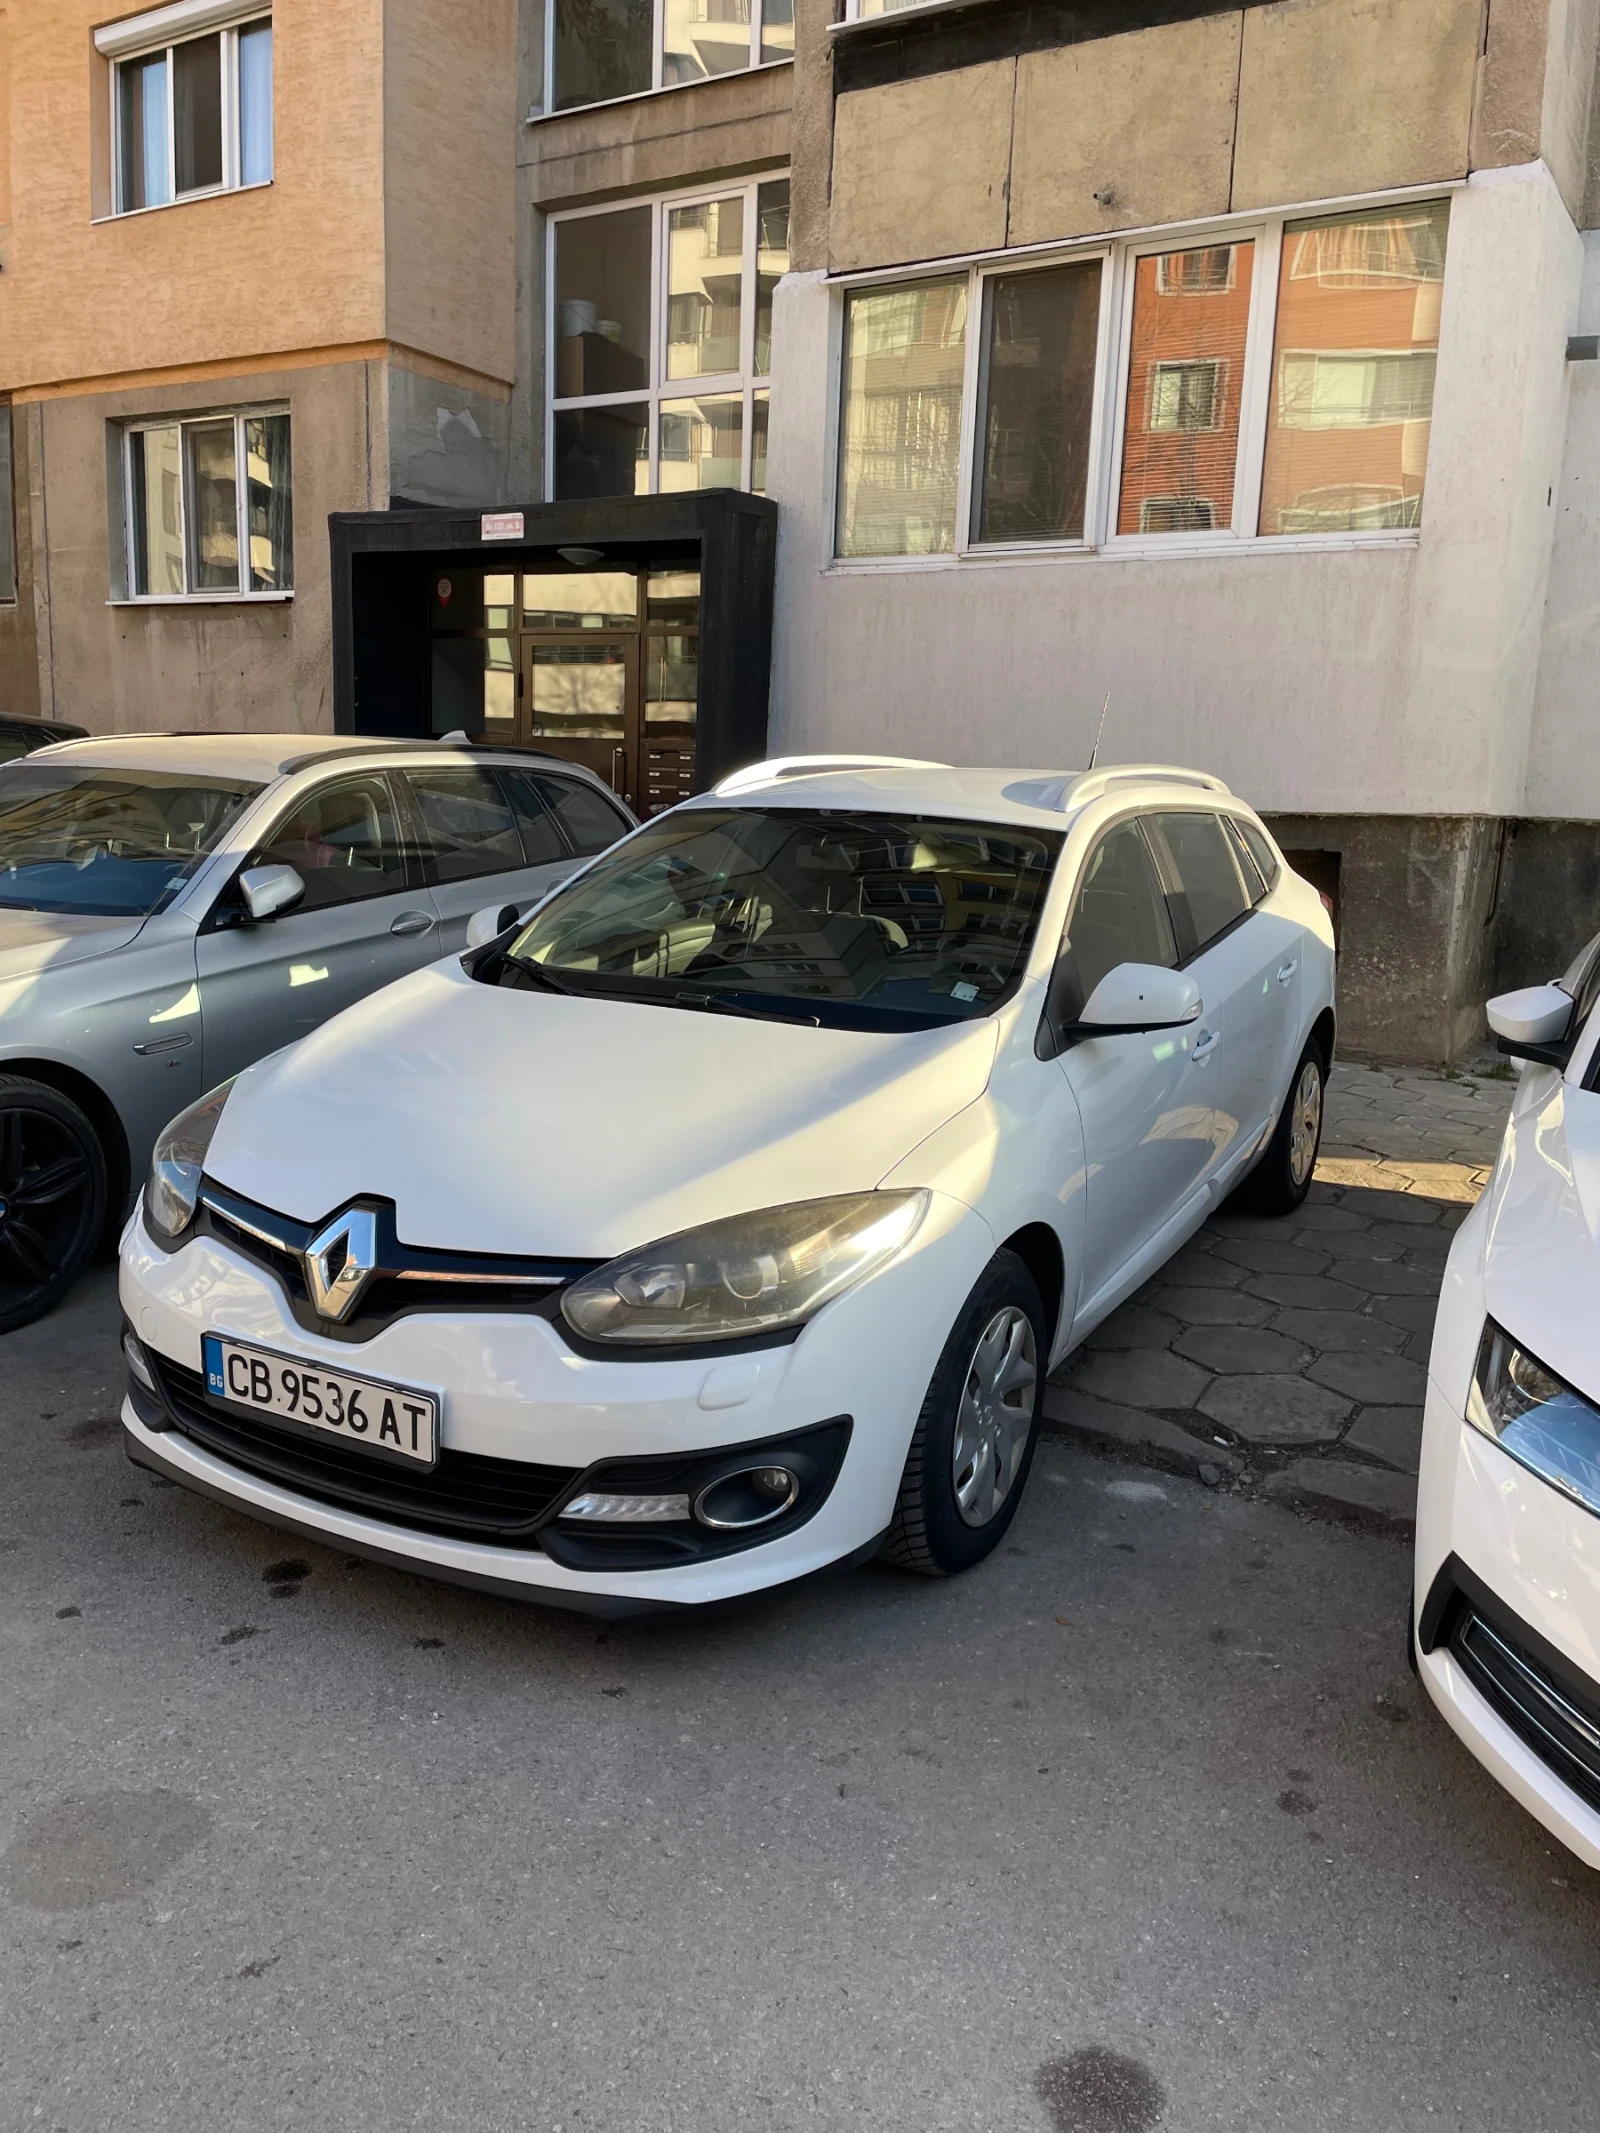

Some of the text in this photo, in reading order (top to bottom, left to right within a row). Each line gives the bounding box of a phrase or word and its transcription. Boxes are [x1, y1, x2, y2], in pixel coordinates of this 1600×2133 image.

[209, 1372, 224, 1388] BG
[281, 1369, 369, 1433] 9536
[379, 1397, 426, 1451] AT
